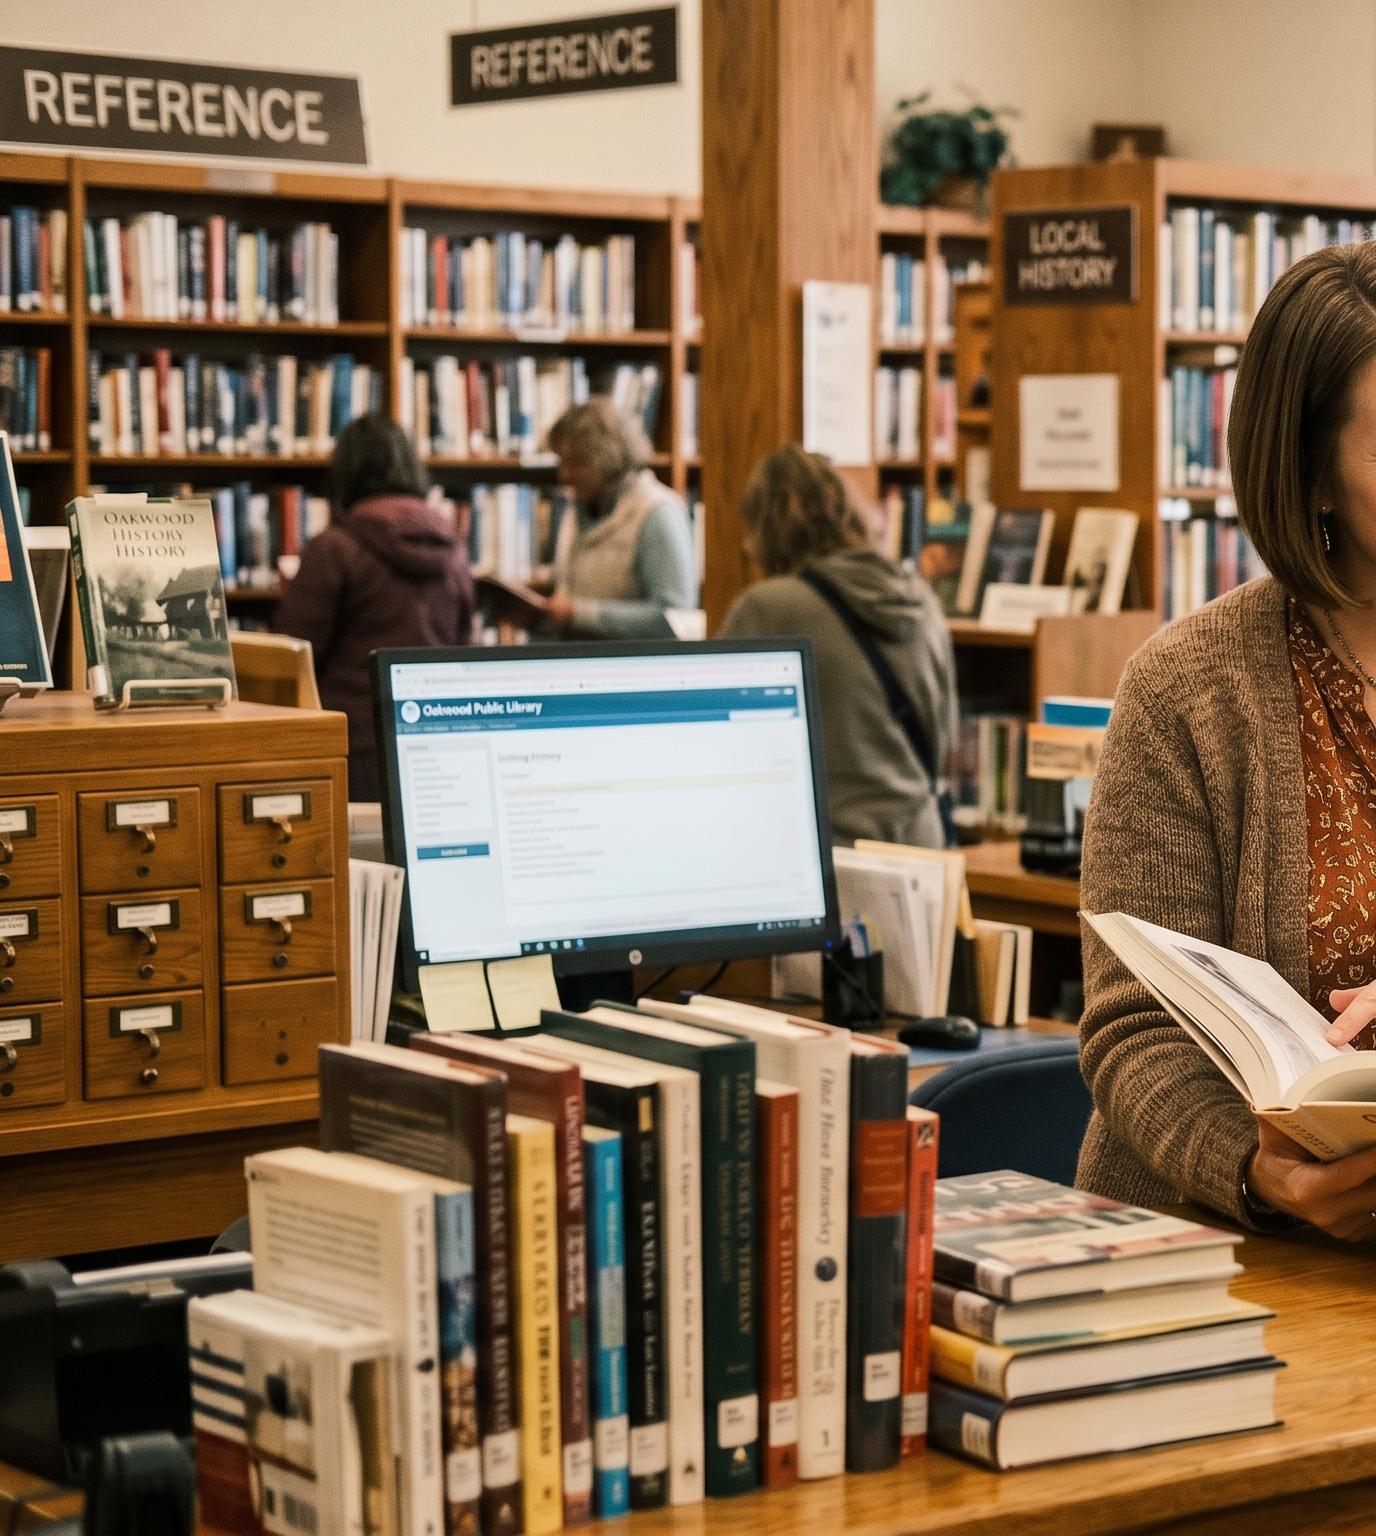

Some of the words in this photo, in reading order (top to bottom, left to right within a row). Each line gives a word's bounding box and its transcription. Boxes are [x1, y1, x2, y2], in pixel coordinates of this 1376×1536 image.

[470, 24, 654, 91] REFERENCE
[23, 68, 330, 146] REFERENCE
[1029, 220, 1106, 254] LOCAL
[1018, 256, 1118, 291] HISTORY
[103, 511, 195, 525] OAKWOOD
[112, 528, 184, 541] HISTORY
[116, 544, 187, 557] HISTORY
[423, 702, 472, 717] Oakwood
[474, 701, 504, 715] Public
[506, 701, 542, 716] Library
